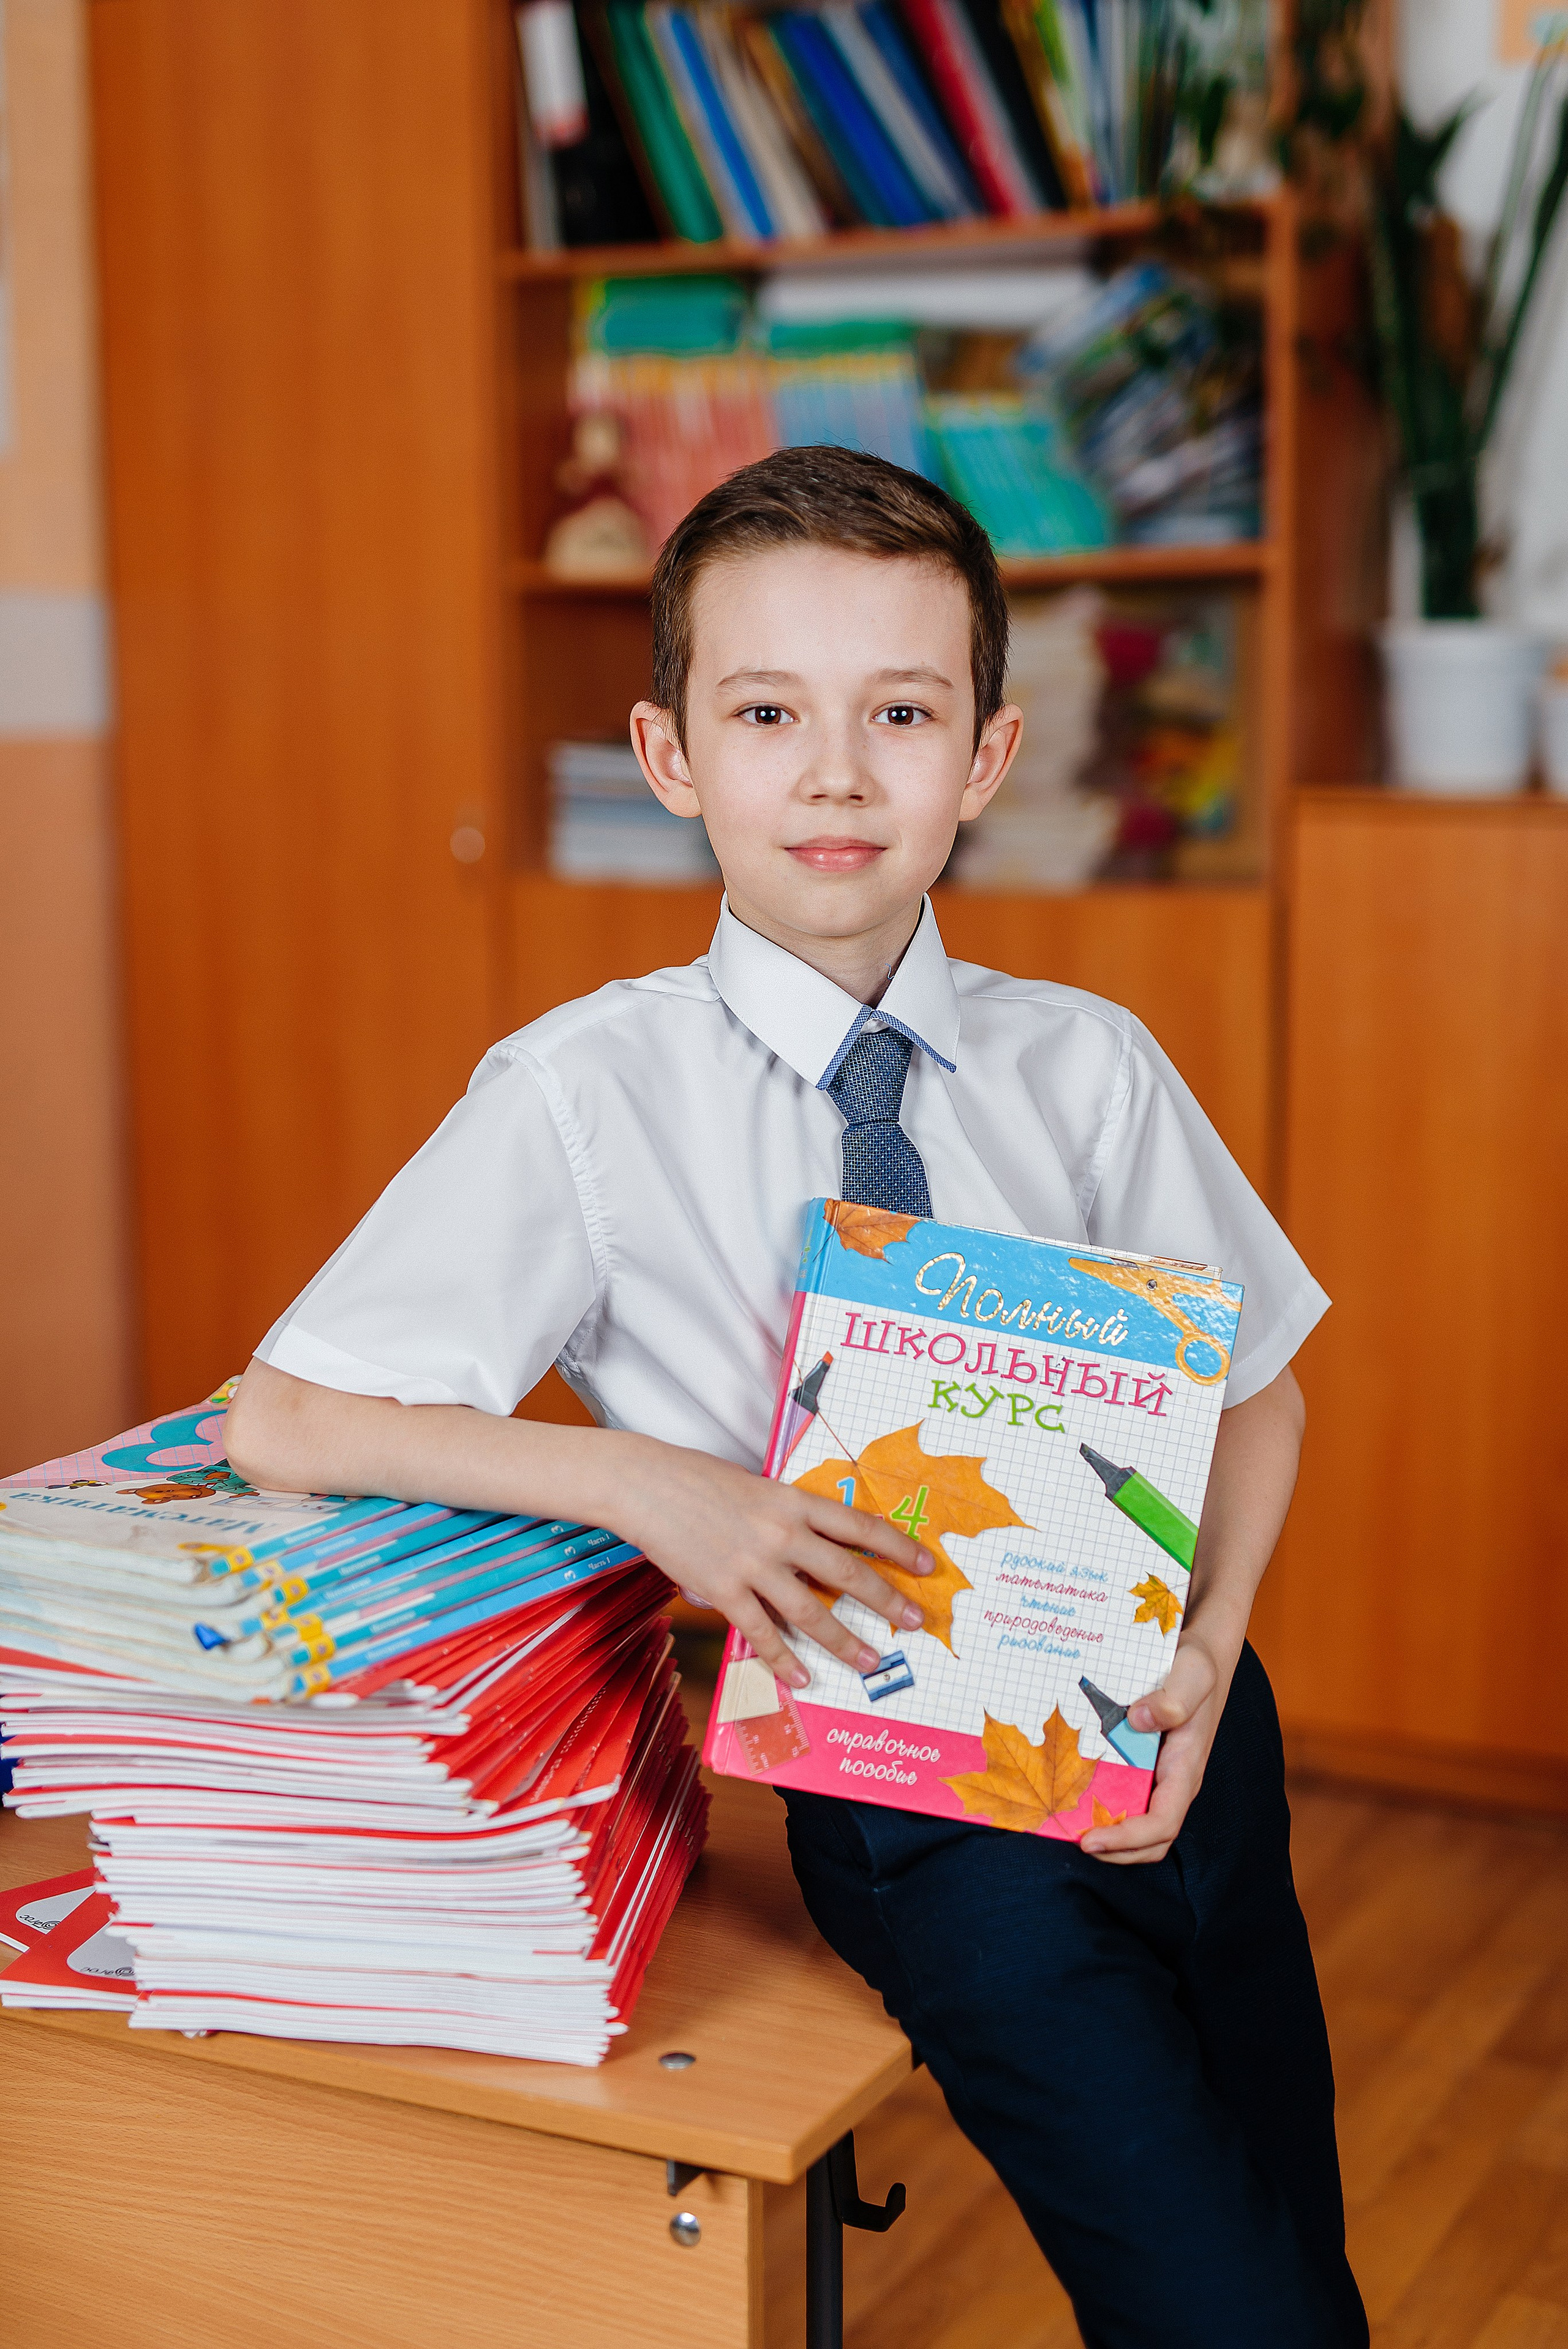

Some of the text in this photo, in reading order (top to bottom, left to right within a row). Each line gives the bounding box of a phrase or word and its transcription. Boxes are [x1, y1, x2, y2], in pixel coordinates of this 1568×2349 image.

[915, 1251, 1129, 1346] Полный
[840, 1312, 1173, 1417] ШКОЛЬНЫЙ
[928, 1379, 1066, 1433] КУРС
[9, 1491, 276, 1534] Математика
[890, 1485, 929, 1541] 4
[1000, 1551, 1109, 1583] русский язык
[995, 1572, 1109, 1602] математика
[1020, 1594, 1076, 1616] чтение
[984, 1609, 1103, 1643] природоведение
[997, 1634, 1080, 1659] рисование
[827, 1728, 941, 1763] справочное
[839, 1757, 918, 1786] пособие
